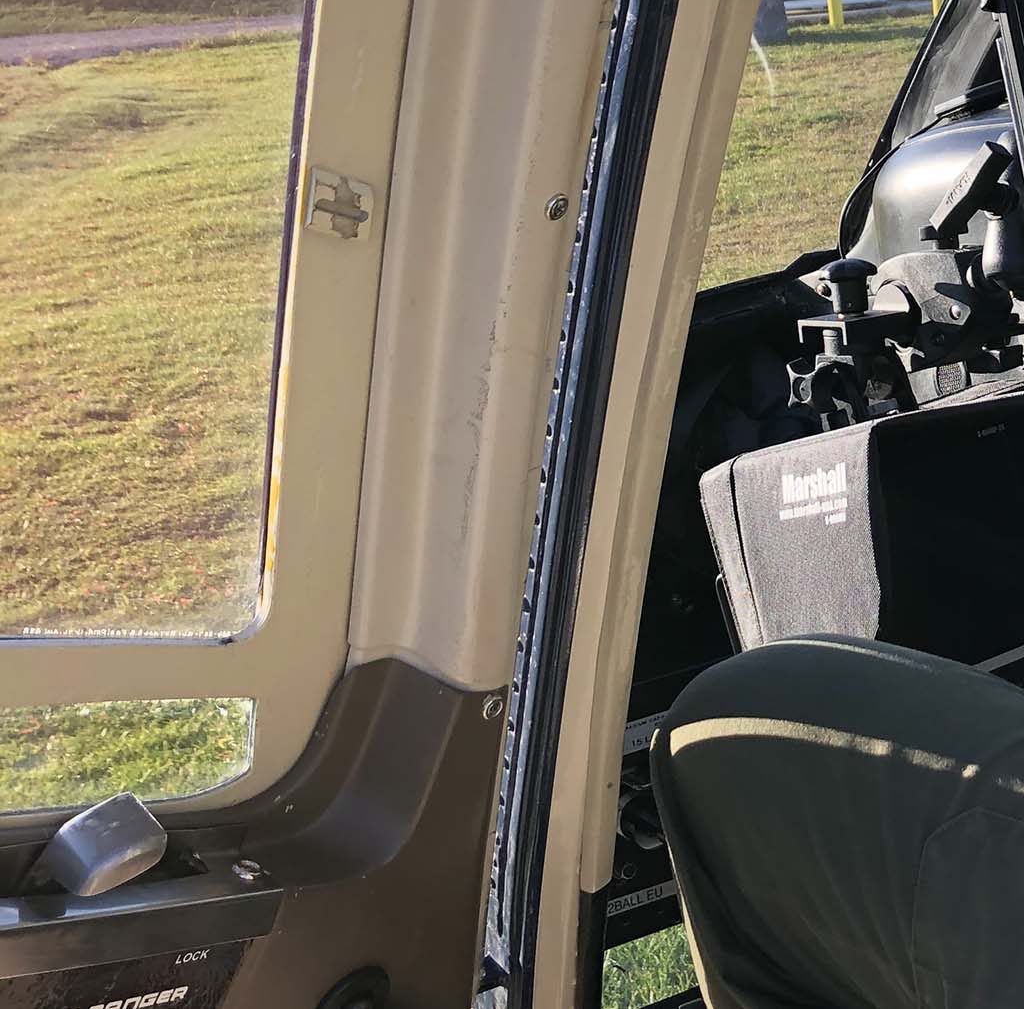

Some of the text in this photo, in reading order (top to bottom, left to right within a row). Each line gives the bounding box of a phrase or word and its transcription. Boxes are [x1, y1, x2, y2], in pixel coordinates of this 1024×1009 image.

[781, 461, 846, 505] Marshall
[646, 885, 663, 902] EU
[175, 948, 210, 965] LOCK
